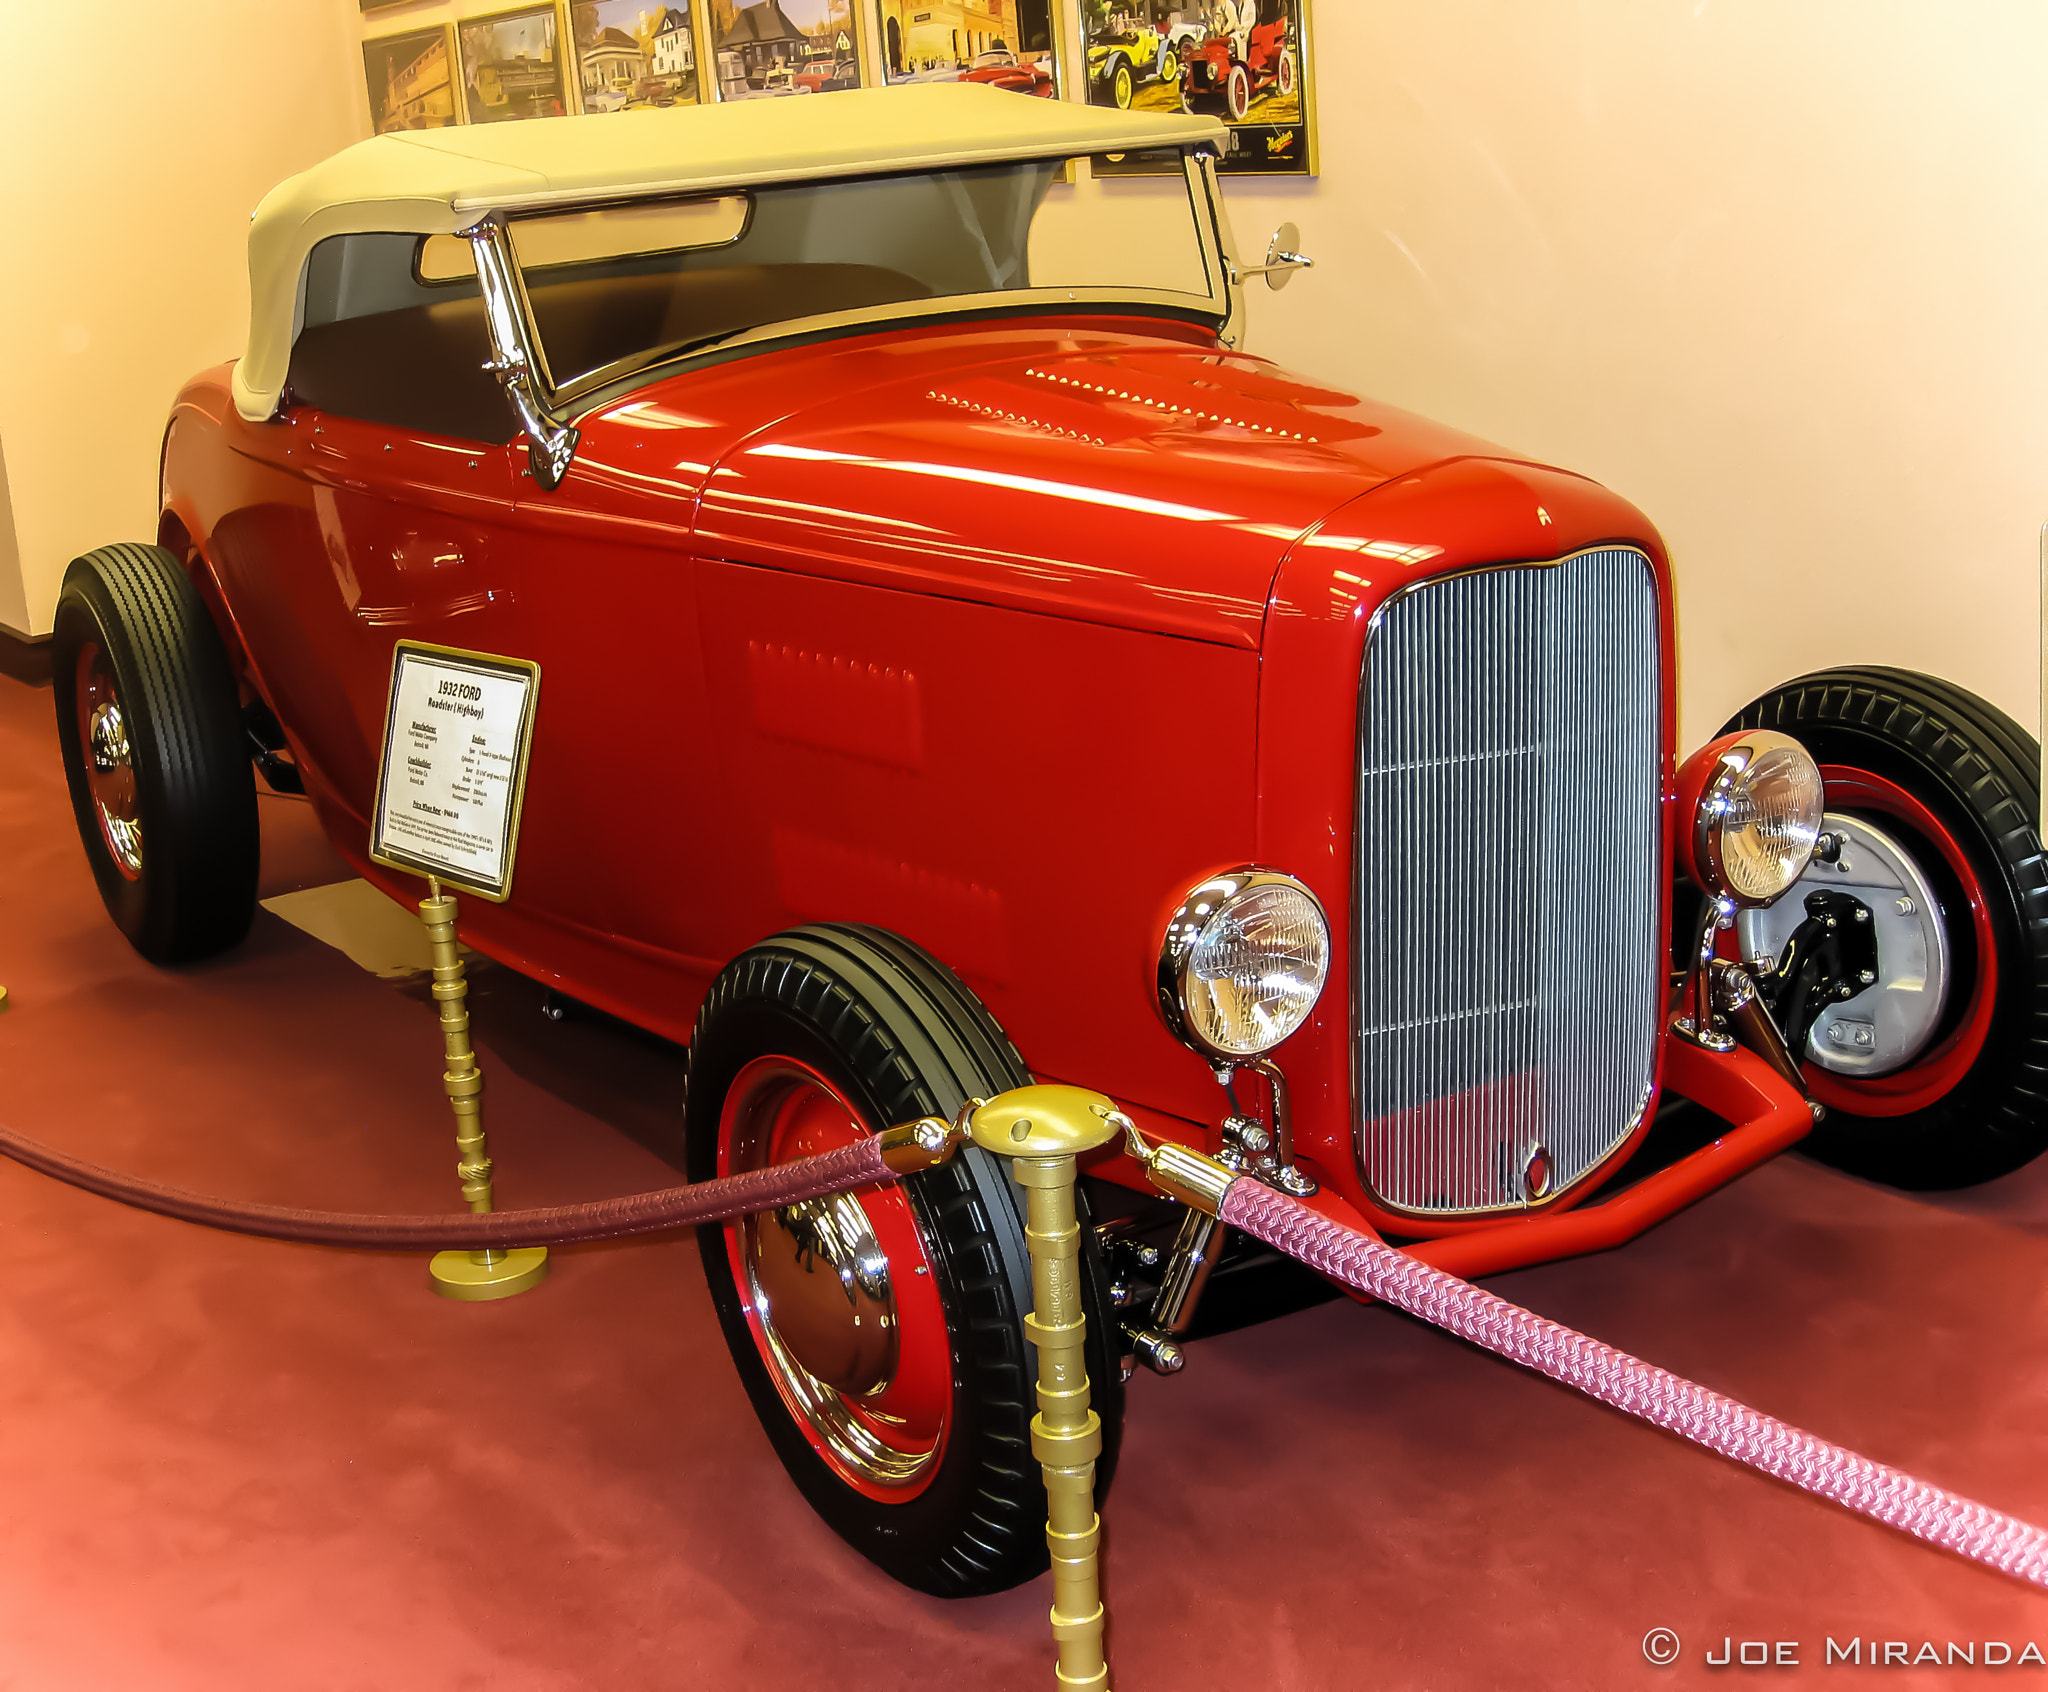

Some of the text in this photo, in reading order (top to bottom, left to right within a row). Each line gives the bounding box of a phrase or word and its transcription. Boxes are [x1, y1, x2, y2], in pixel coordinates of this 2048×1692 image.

[438, 680, 482, 701] 1932 FORD
[428, 697, 453, 711] Roadster
